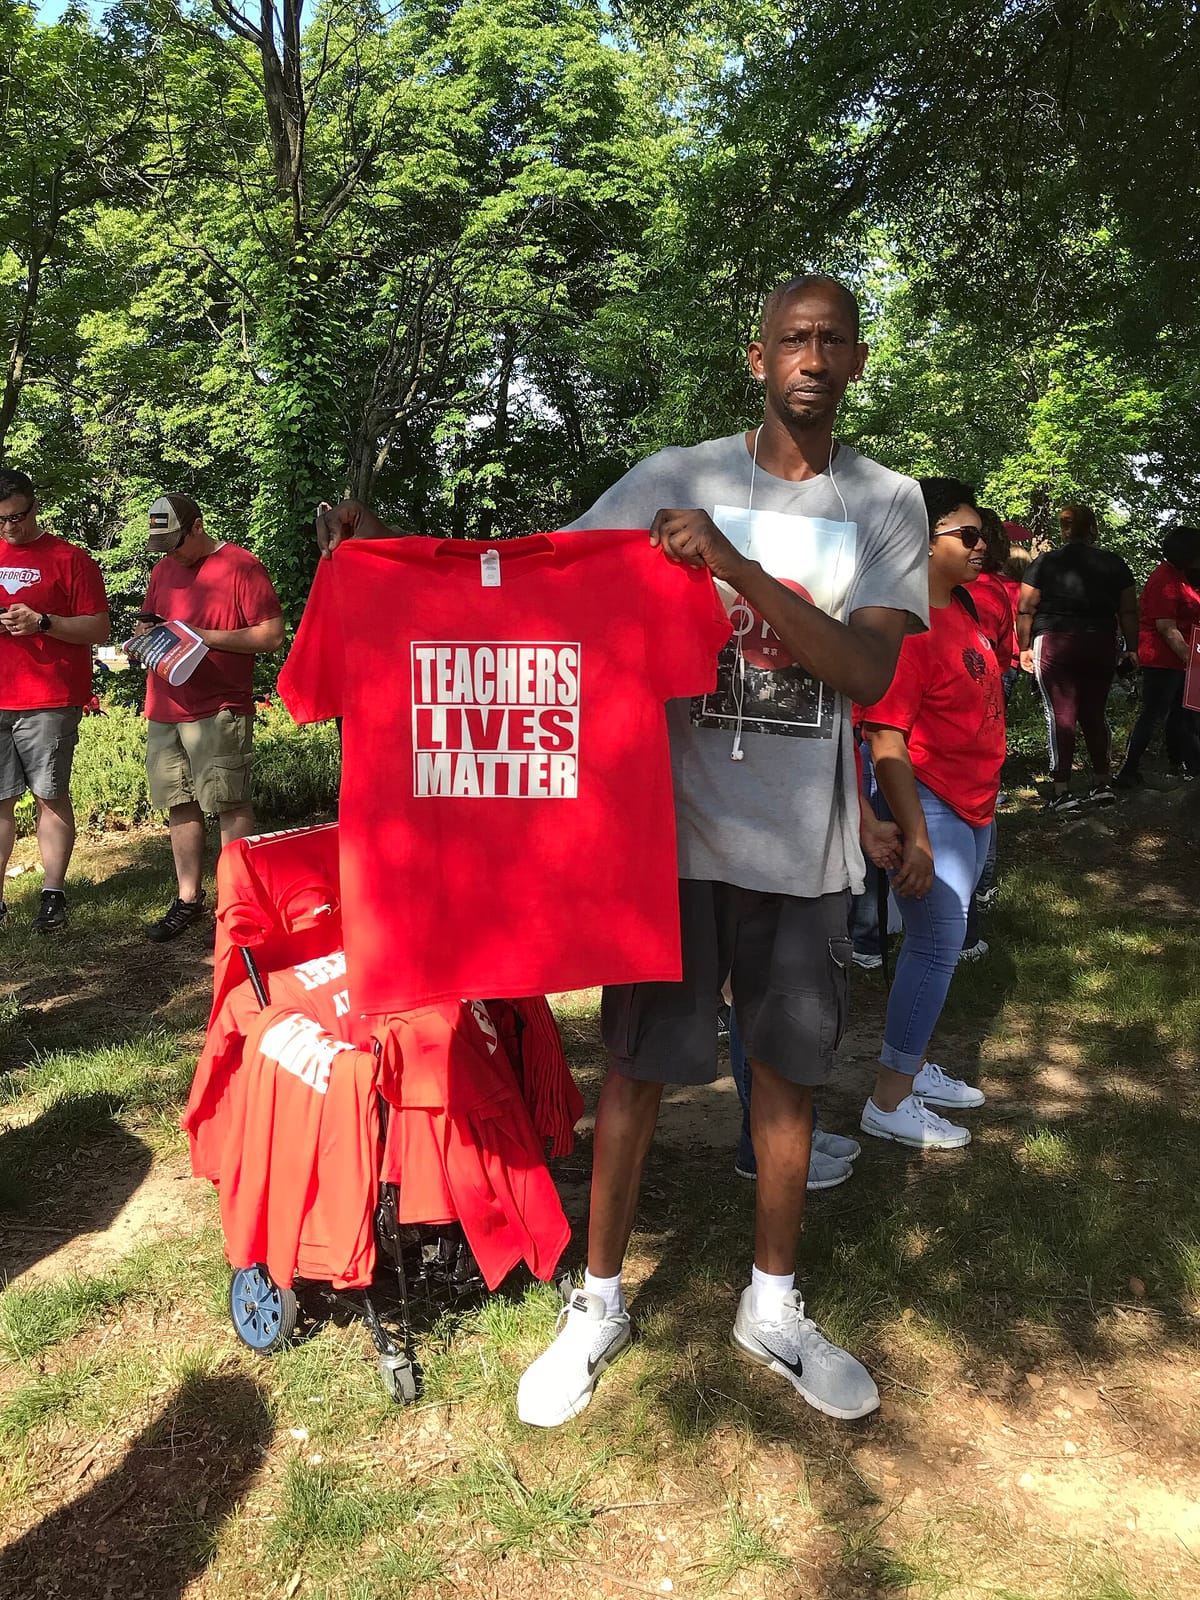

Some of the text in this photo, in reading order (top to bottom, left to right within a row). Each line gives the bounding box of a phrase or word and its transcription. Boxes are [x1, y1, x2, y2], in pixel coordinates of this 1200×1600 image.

[416, 647, 577, 705] TEACHERS
[416, 708, 574, 752] LIVES
[417, 753, 576, 796] MATTER
